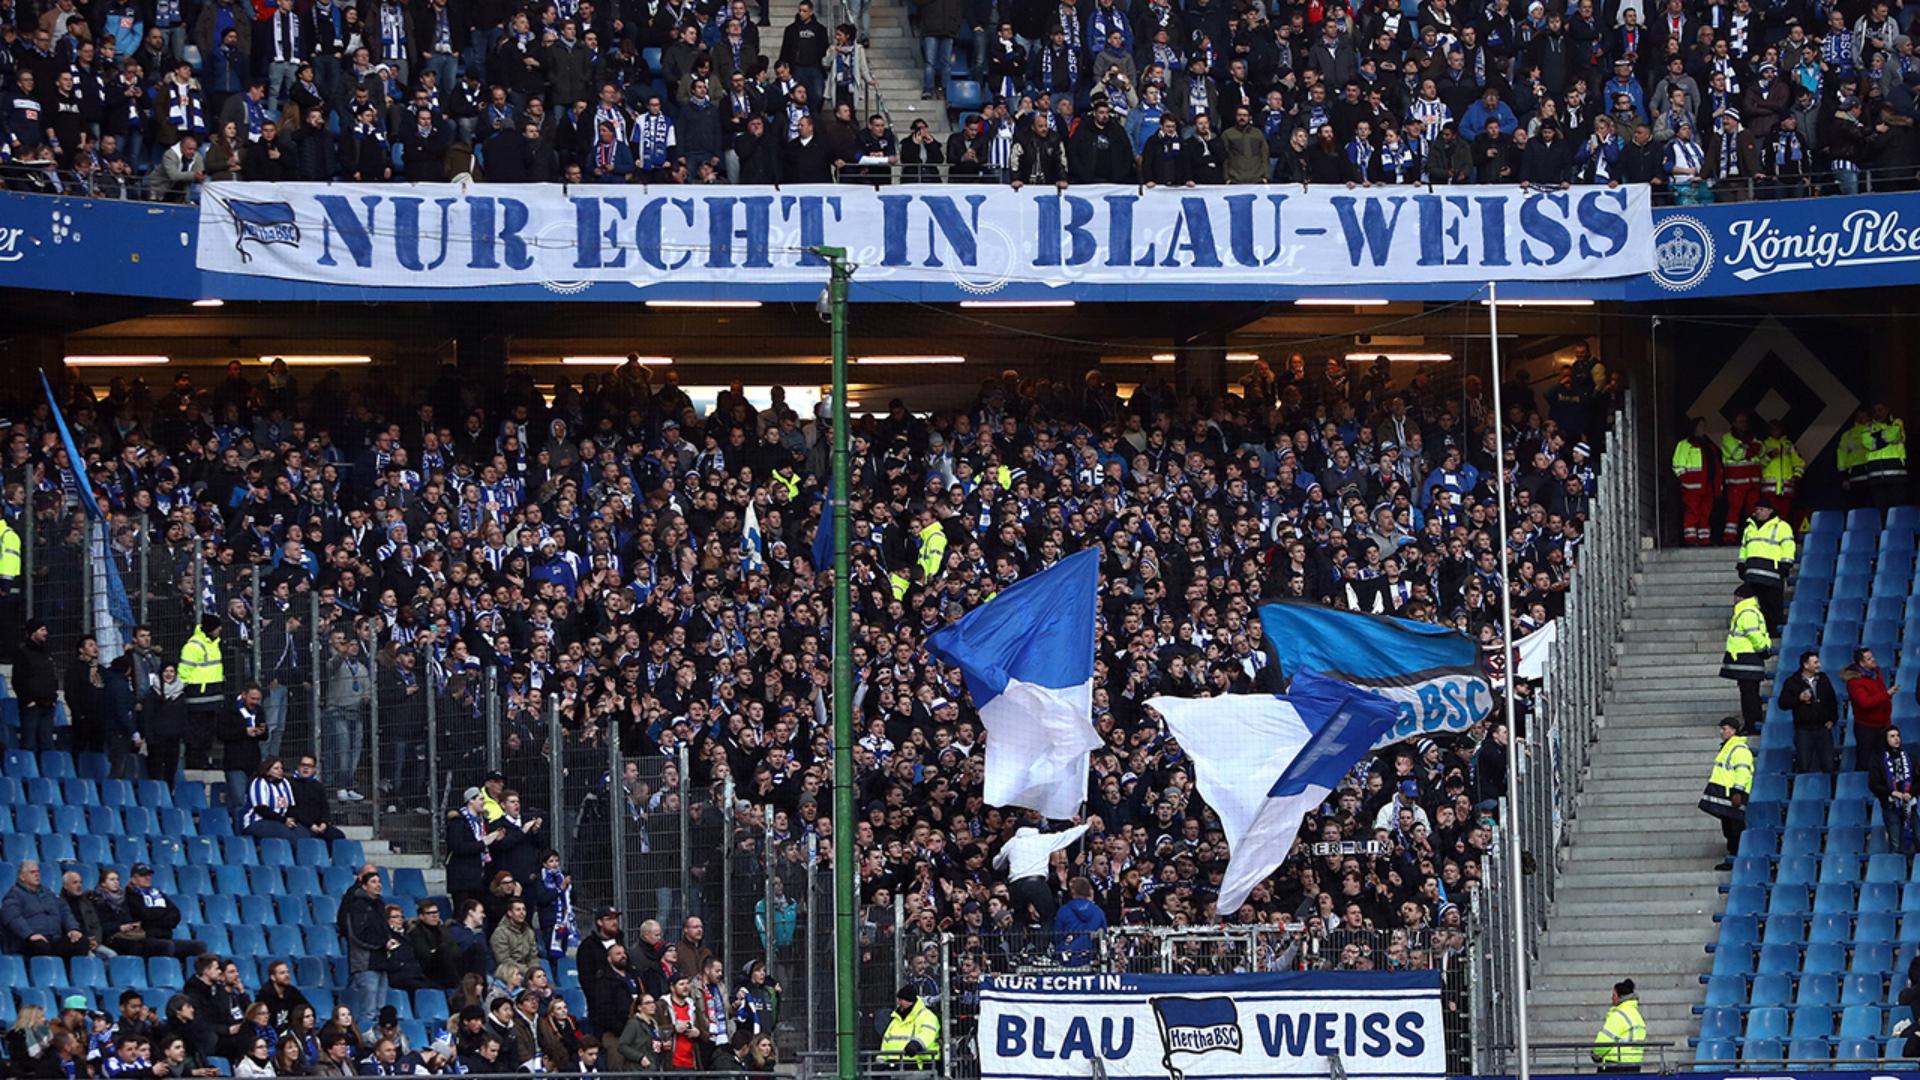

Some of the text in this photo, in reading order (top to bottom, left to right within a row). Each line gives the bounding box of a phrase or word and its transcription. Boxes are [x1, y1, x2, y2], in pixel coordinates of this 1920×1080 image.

[314, 194, 534, 271] NUR
[570, 195, 842, 270] ECHT
[877, 195, 987, 267] IN
[994, 974, 1037, 990] NUR
[1042, 975, 1096, 991] ECHT
[997, 1013, 1134, 1060] BLAU
[1256, 1011, 1425, 1057] WEISS
